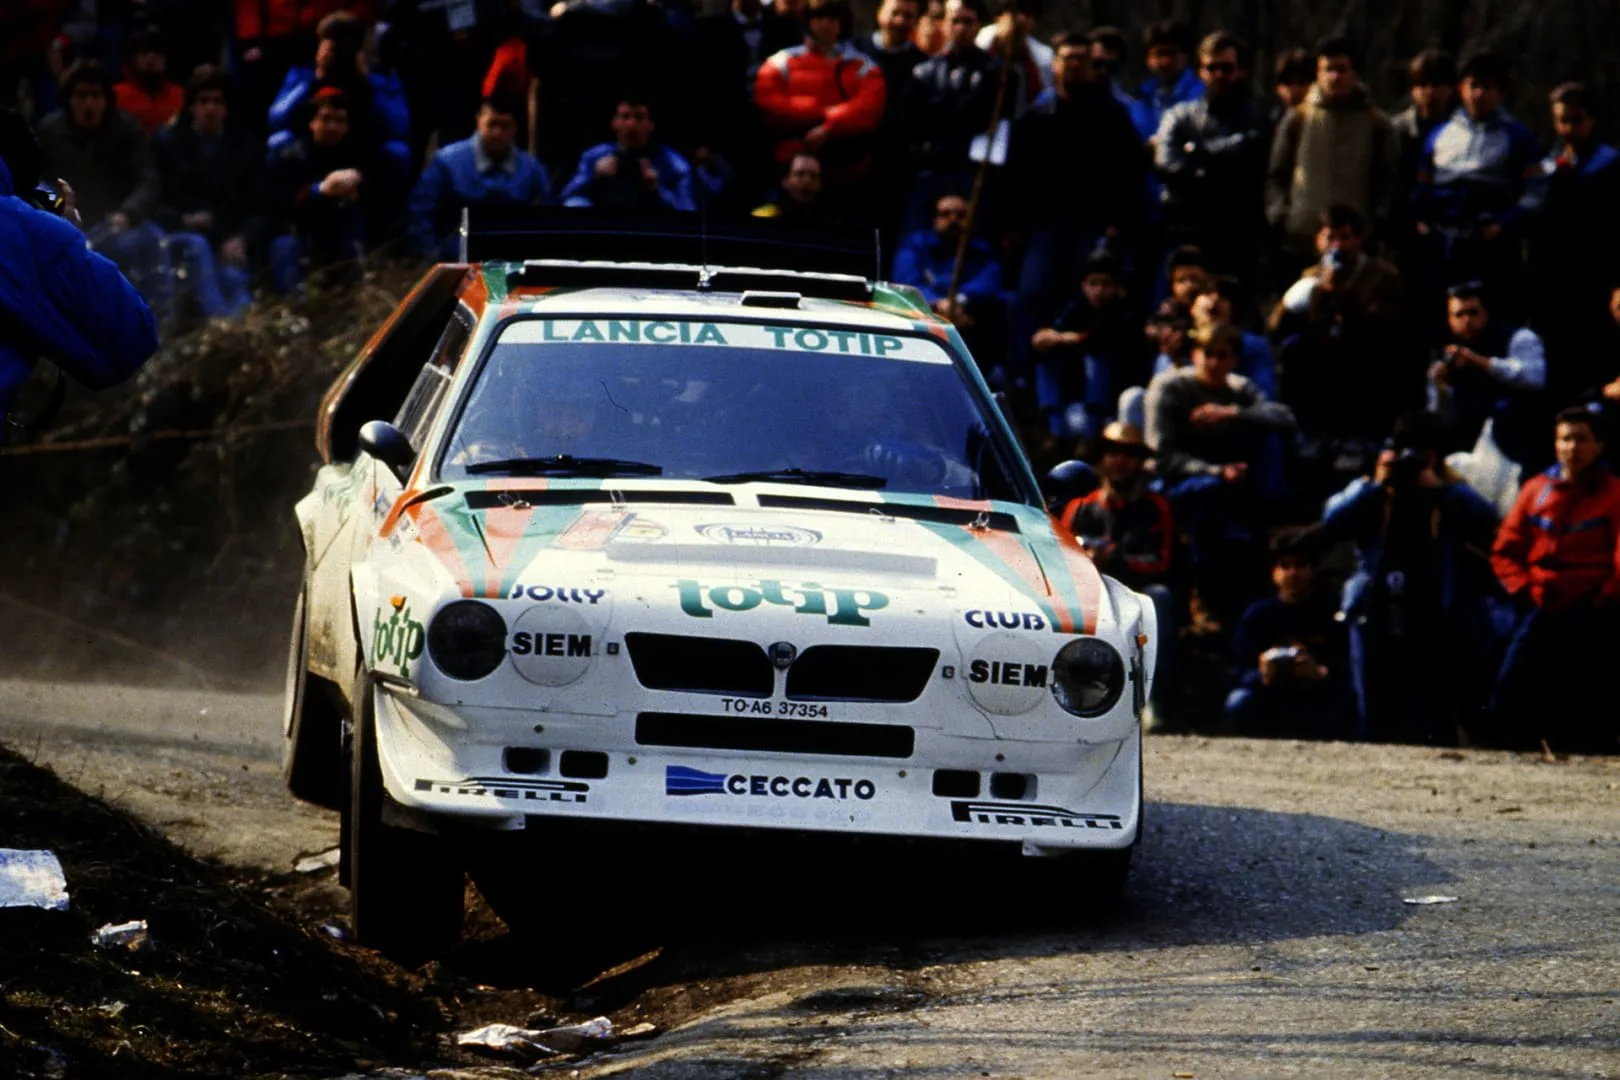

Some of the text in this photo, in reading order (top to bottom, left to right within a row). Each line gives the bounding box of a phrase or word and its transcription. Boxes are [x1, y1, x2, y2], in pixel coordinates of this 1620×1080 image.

[542, 319, 904, 357] LANCIA TOTIP
[668, 579, 890, 627] totip
[964, 609, 1046, 631] CLUB
[370, 605, 425, 678] totip
[511, 631, 592, 658] SIEM
[968, 659, 1048, 688] SIEM
[778, 702, 829, 718] 37354
[727, 774, 876, 800] CECCATO
[950, 800, 1123, 829] PIRELLI
